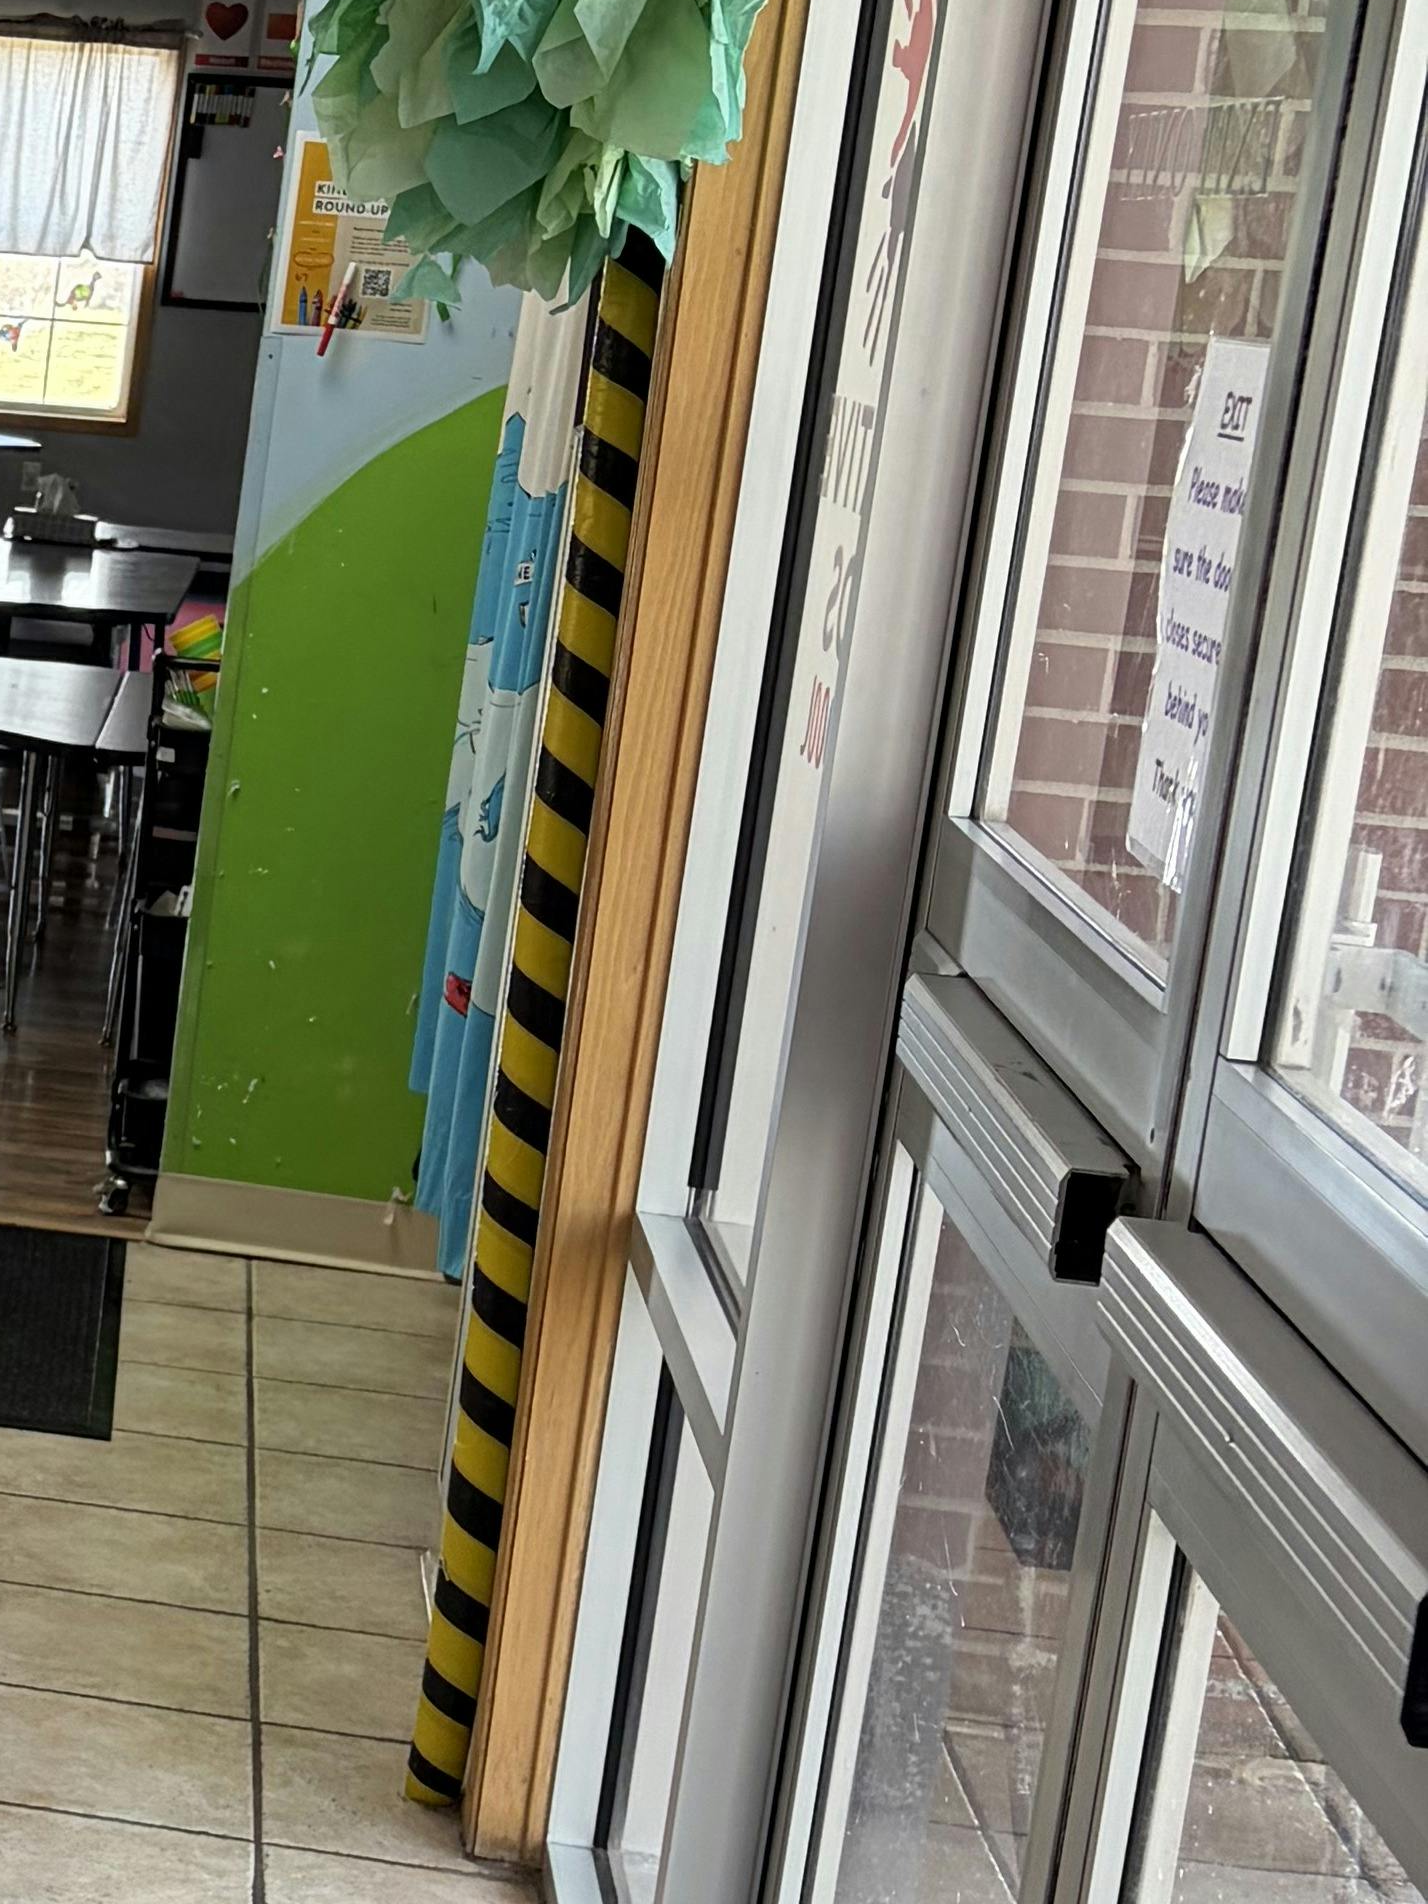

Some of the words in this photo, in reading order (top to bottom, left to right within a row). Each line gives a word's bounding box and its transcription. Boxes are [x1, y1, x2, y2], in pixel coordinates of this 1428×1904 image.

[315, 200, 366, 214] ROUND
[370, 204, 389, 216] UP
[1219, 390, 1254, 432] EXIT
[1188, 465, 1220, 510] Please
[1173, 547, 1194, 577] sure
[1195, 544, 1212, 585] the
[1166, 608, 1190, 652] closes
[1164, 680, 1197, 729] behind
